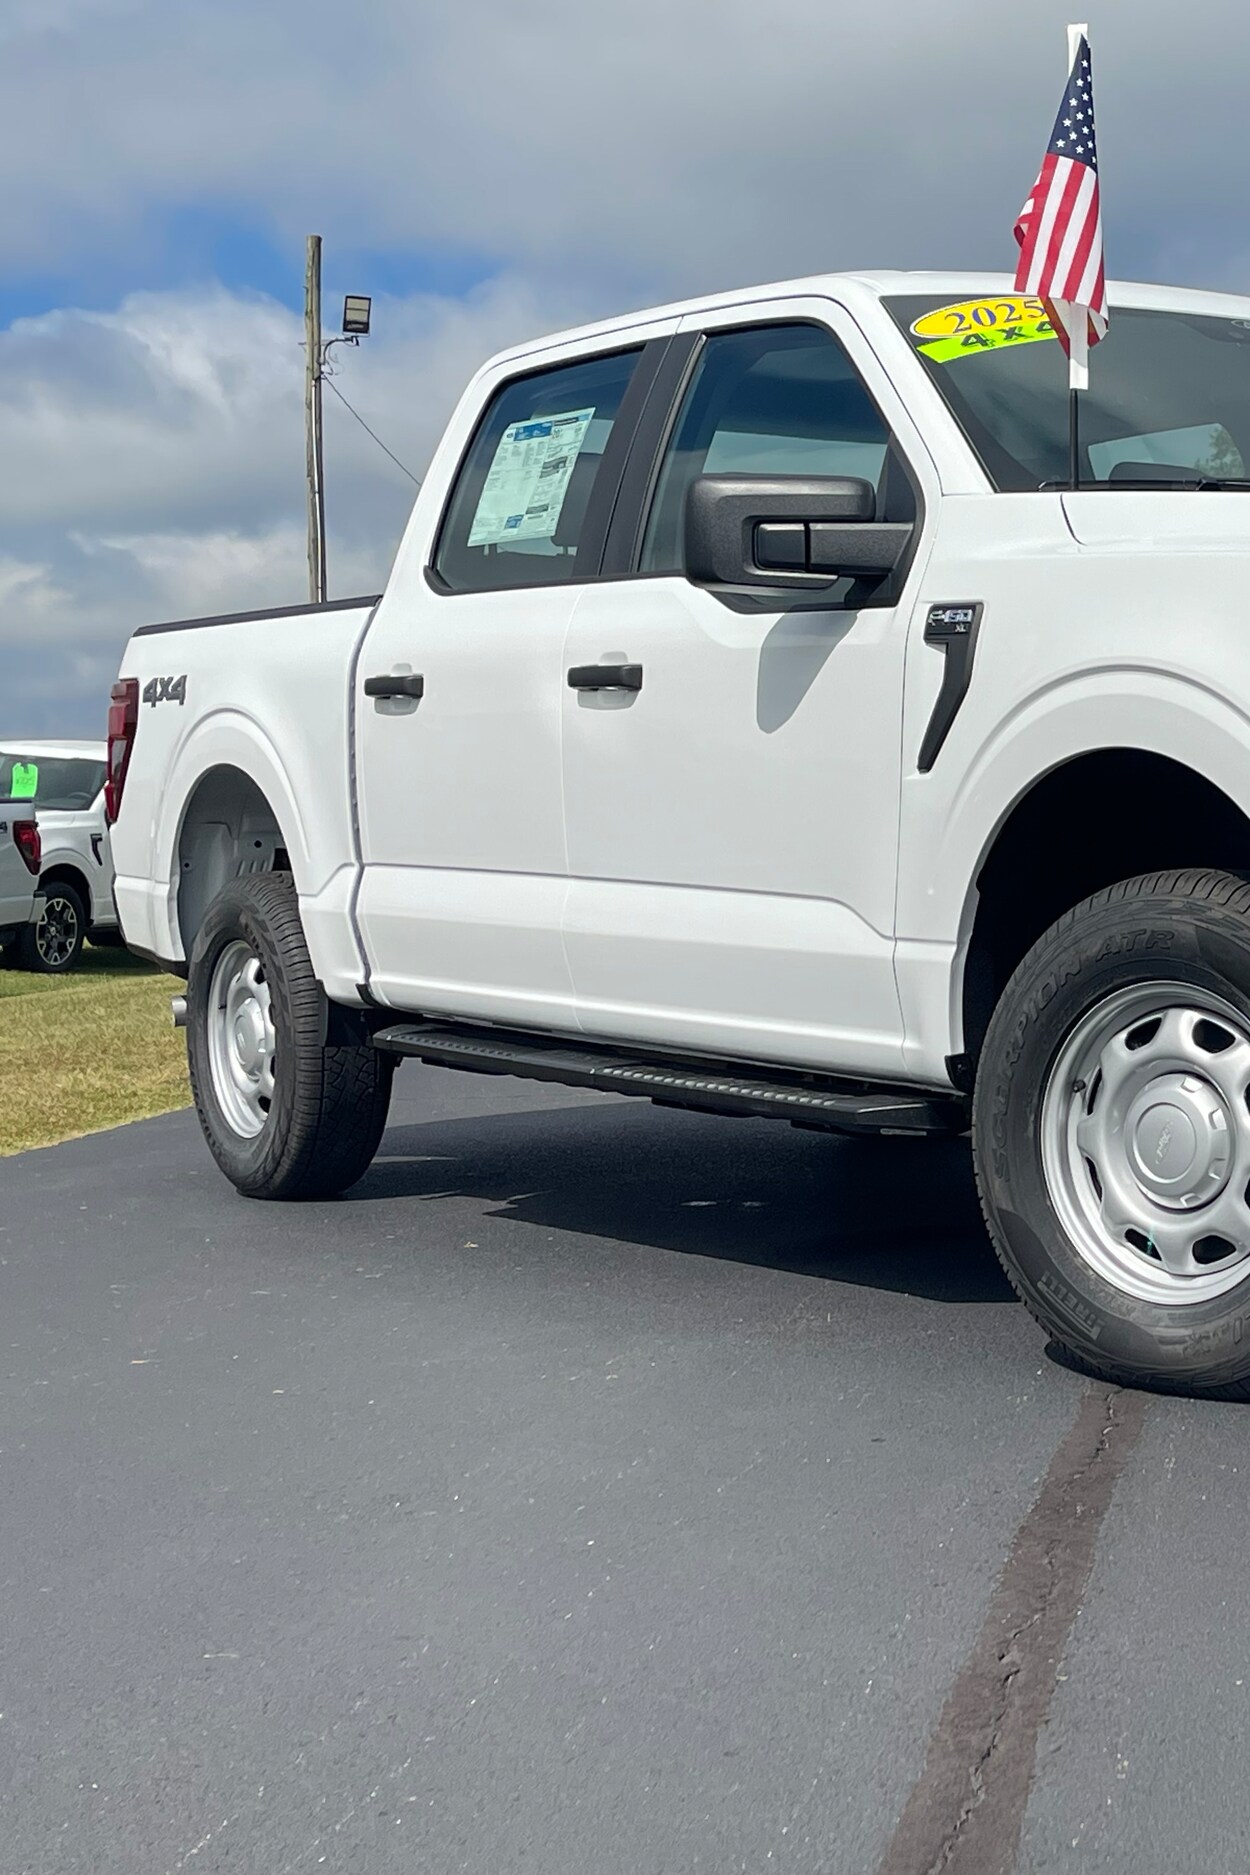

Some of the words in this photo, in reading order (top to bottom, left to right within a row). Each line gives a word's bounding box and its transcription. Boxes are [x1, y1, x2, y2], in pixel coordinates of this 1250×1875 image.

[944, 300, 1046, 334] 2025
[142, 675, 187, 708] 4X4
[1096, 928, 1177, 963] ATR
